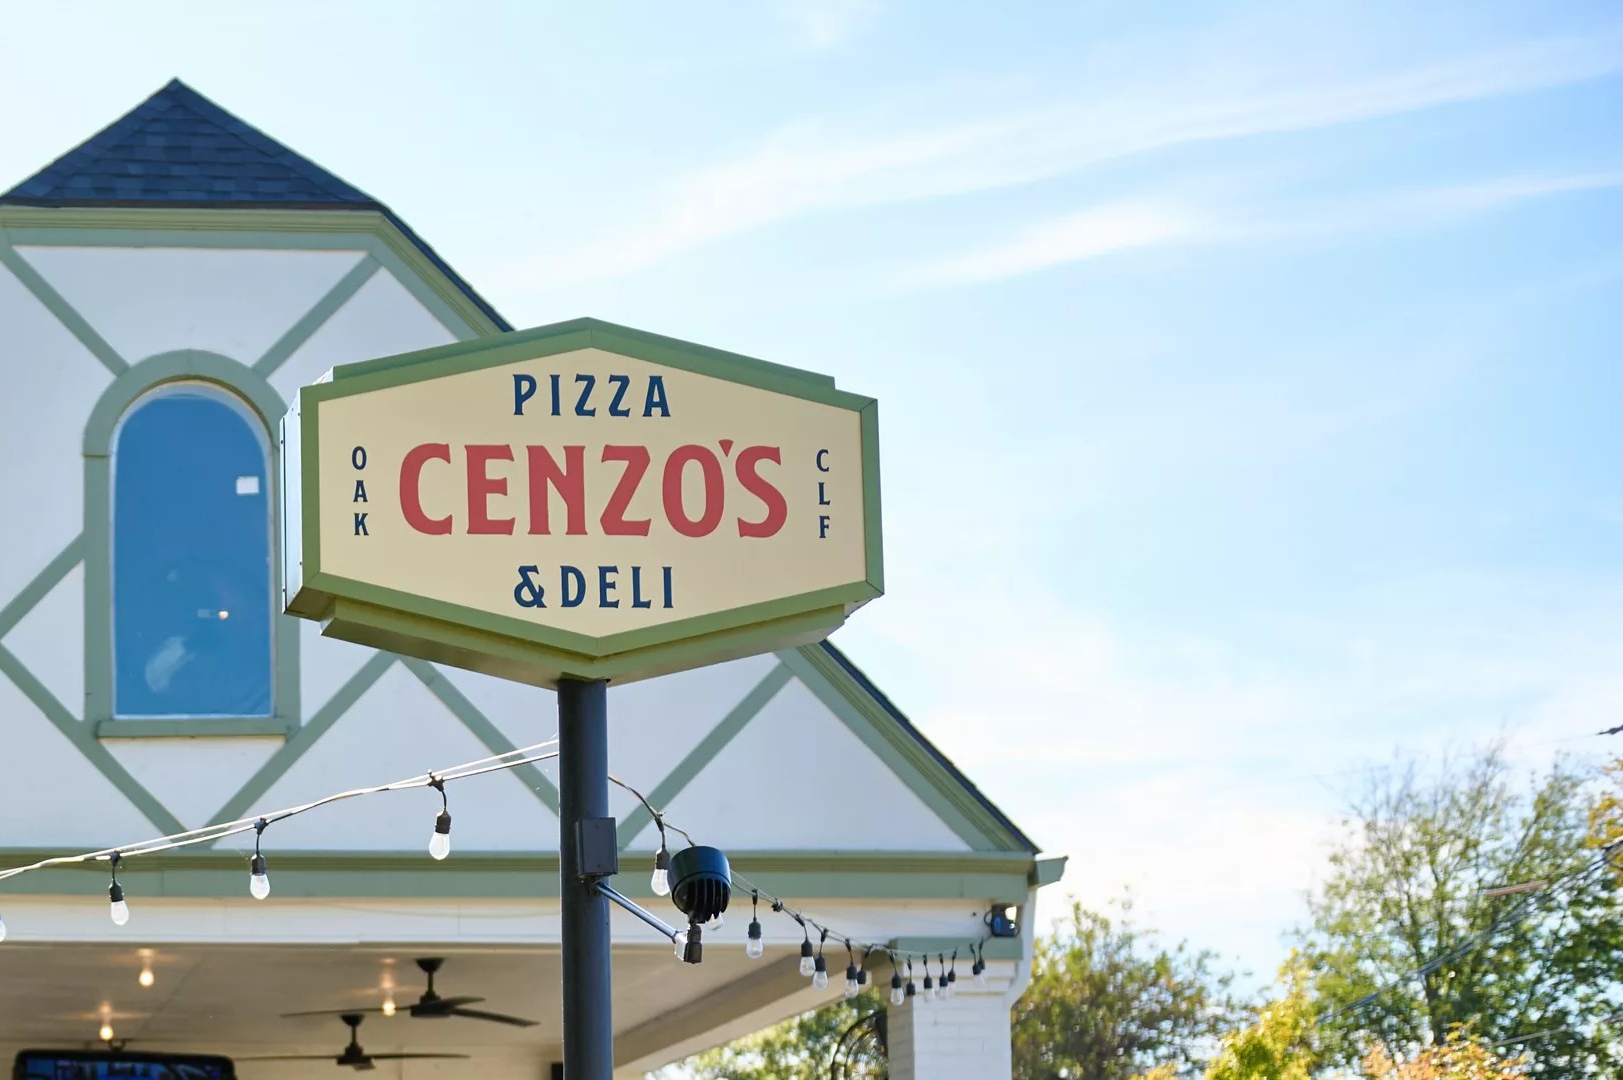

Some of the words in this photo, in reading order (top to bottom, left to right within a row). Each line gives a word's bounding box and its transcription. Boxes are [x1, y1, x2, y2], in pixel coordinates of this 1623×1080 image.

[512, 373, 672, 418] PIZZA
[351, 445, 370, 536] OAK
[399, 438, 788, 538] CENZO'S
[815, 448, 831, 539] CLF
